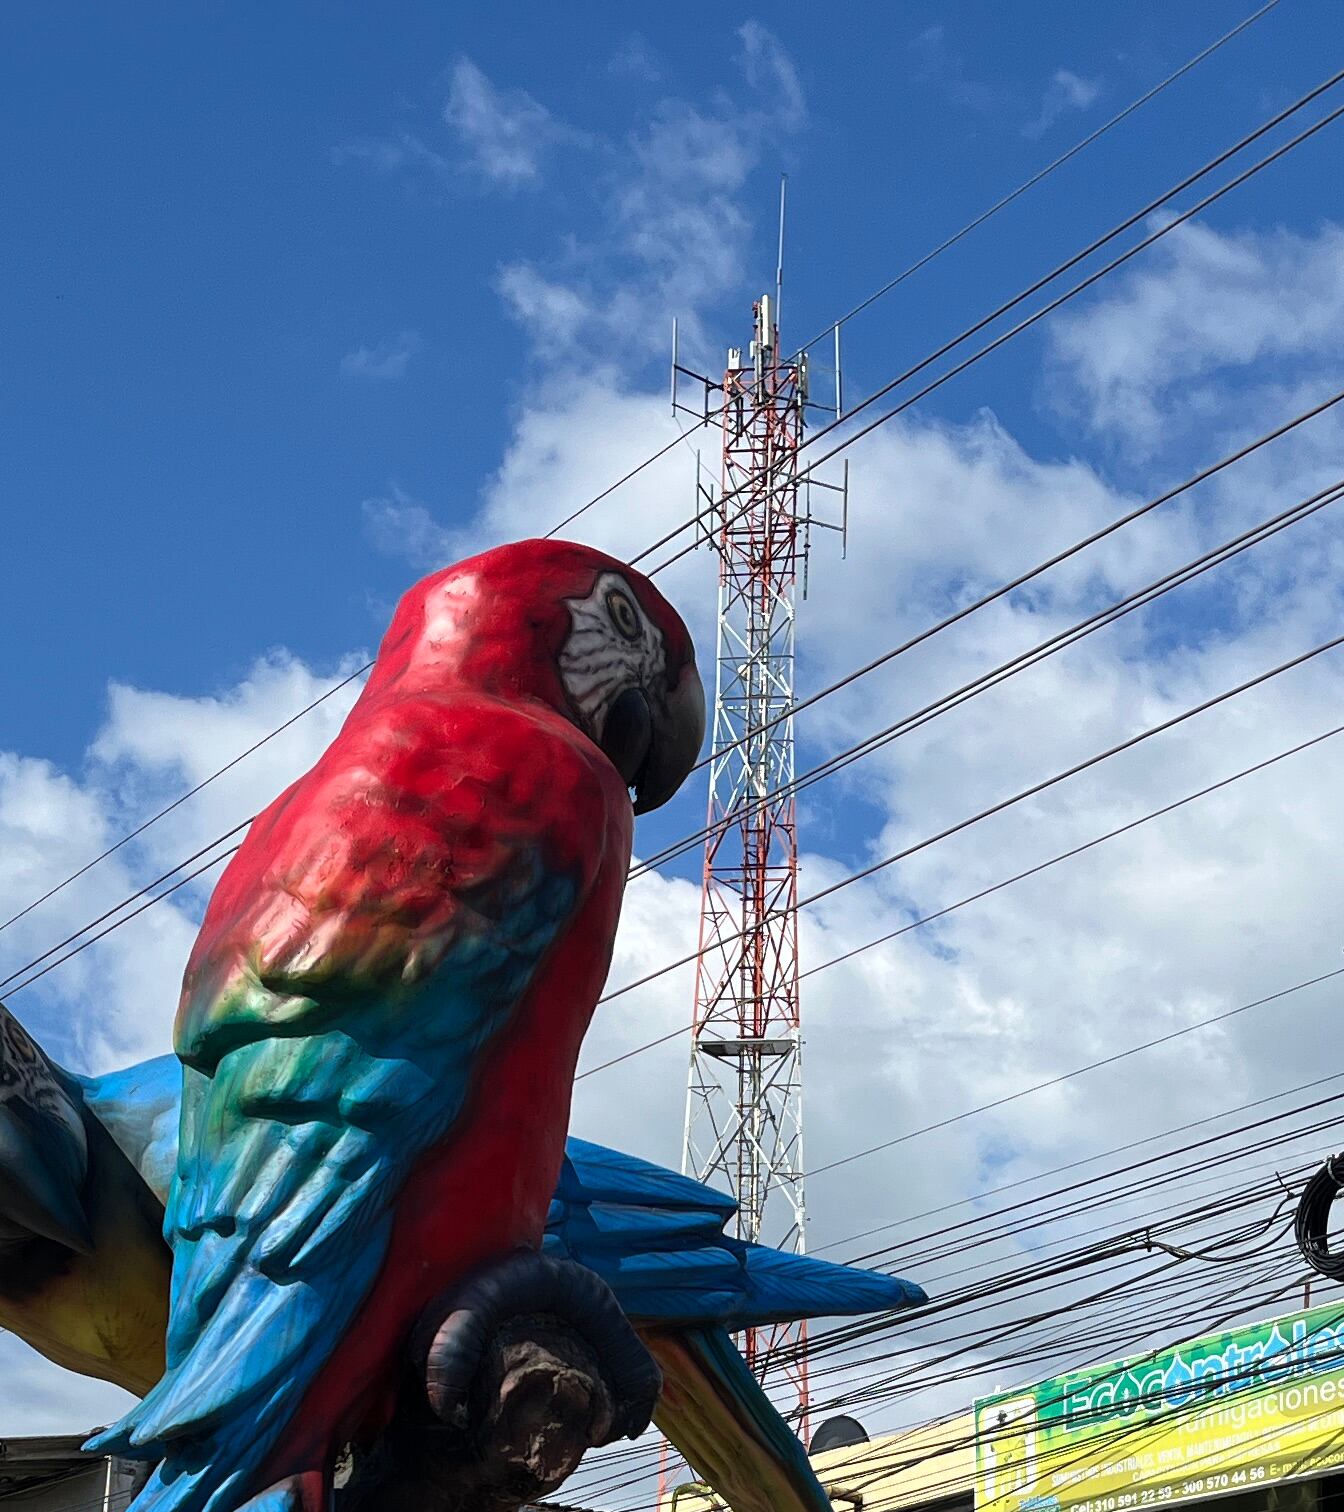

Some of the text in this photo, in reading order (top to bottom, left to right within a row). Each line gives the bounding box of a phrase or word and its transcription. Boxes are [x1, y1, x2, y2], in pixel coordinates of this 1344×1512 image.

[1117, 1492, 1138, 1507] 591
[1182, 1479, 1204, 1495] 300
[1206, 1474, 1229, 1490] 570
[1230, 1470, 1247, 1484] 44
[1249, 1466, 1265, 1481] 56
